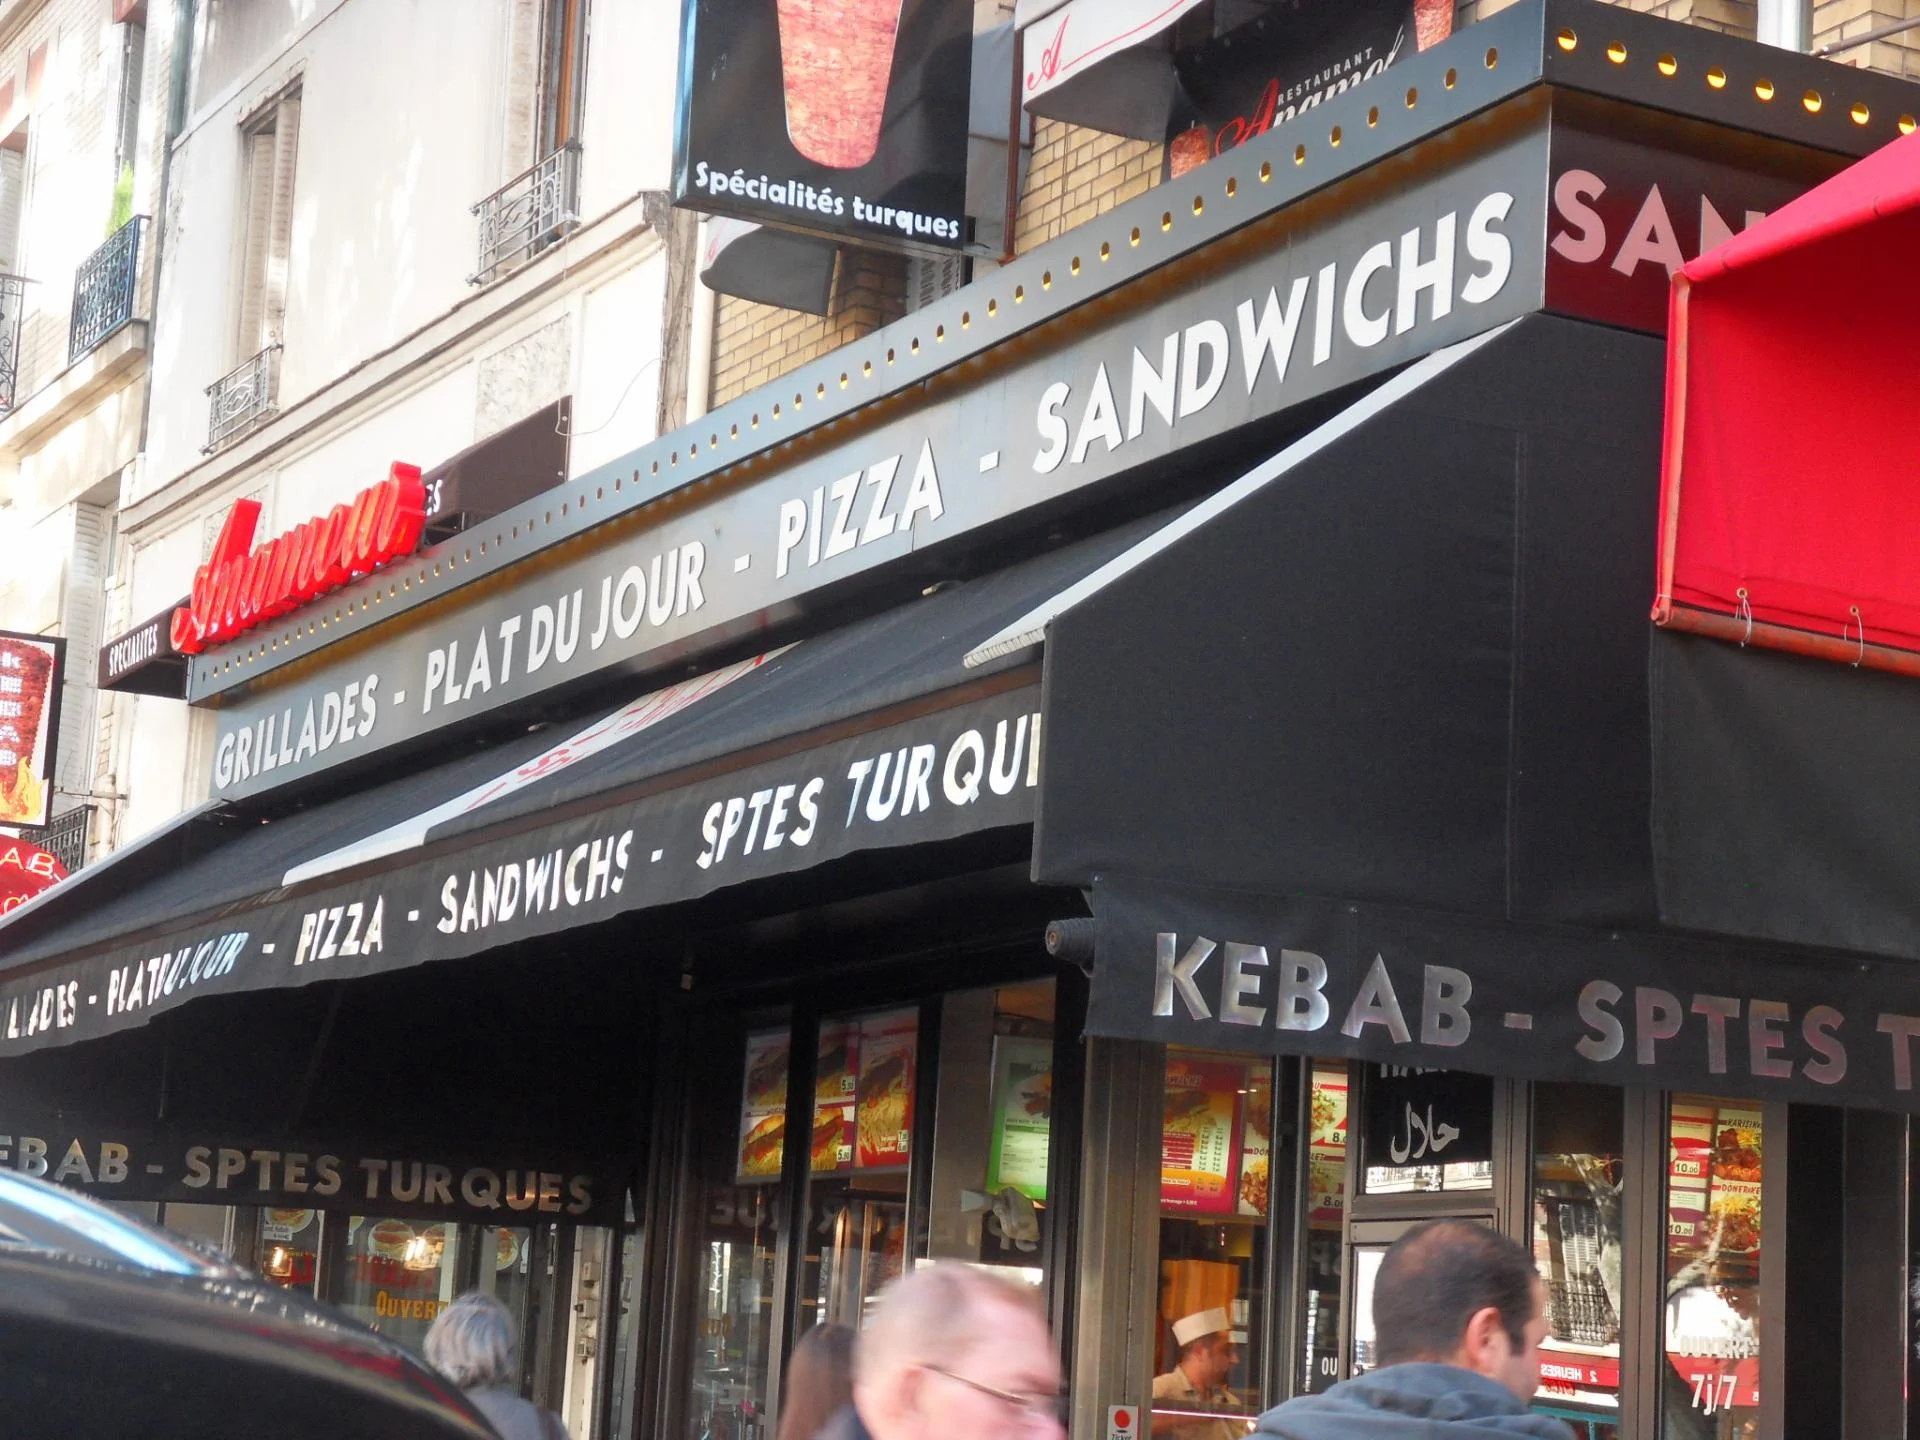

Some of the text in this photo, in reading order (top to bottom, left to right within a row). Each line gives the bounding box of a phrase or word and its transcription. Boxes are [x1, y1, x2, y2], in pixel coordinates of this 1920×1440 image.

[1277, 47, 1373, 106] RESTAURANT
[695, 160, 959, 240] Spécialités turques
[214, 674, 378, 790] GRILLADES
[422, 614, 522, 714] PLAT
[526, 589, 584, 675] DU
[591, 541, 706, 651] JOUR
[775, 437, 945, 579] PIZZA
[1032, 192, 1514, 474] SANDWICHS
[294, 895, 384, 966] PIZZA
[437, 830, 634, 934] SANDWICHS
[696, 777, 825, 870] SPTES
[1153, 931, 1473, 1047] KEBAB
[1575, 980, 1848, 1085] SPTES
[1391, 1101, 1460, 1164] حلال
[182, 1146, 342, 1196] SPTES
[360, 1158, 594, 1215] TURQUES
[1690, 1373, 1738, 1416] 7j/7
